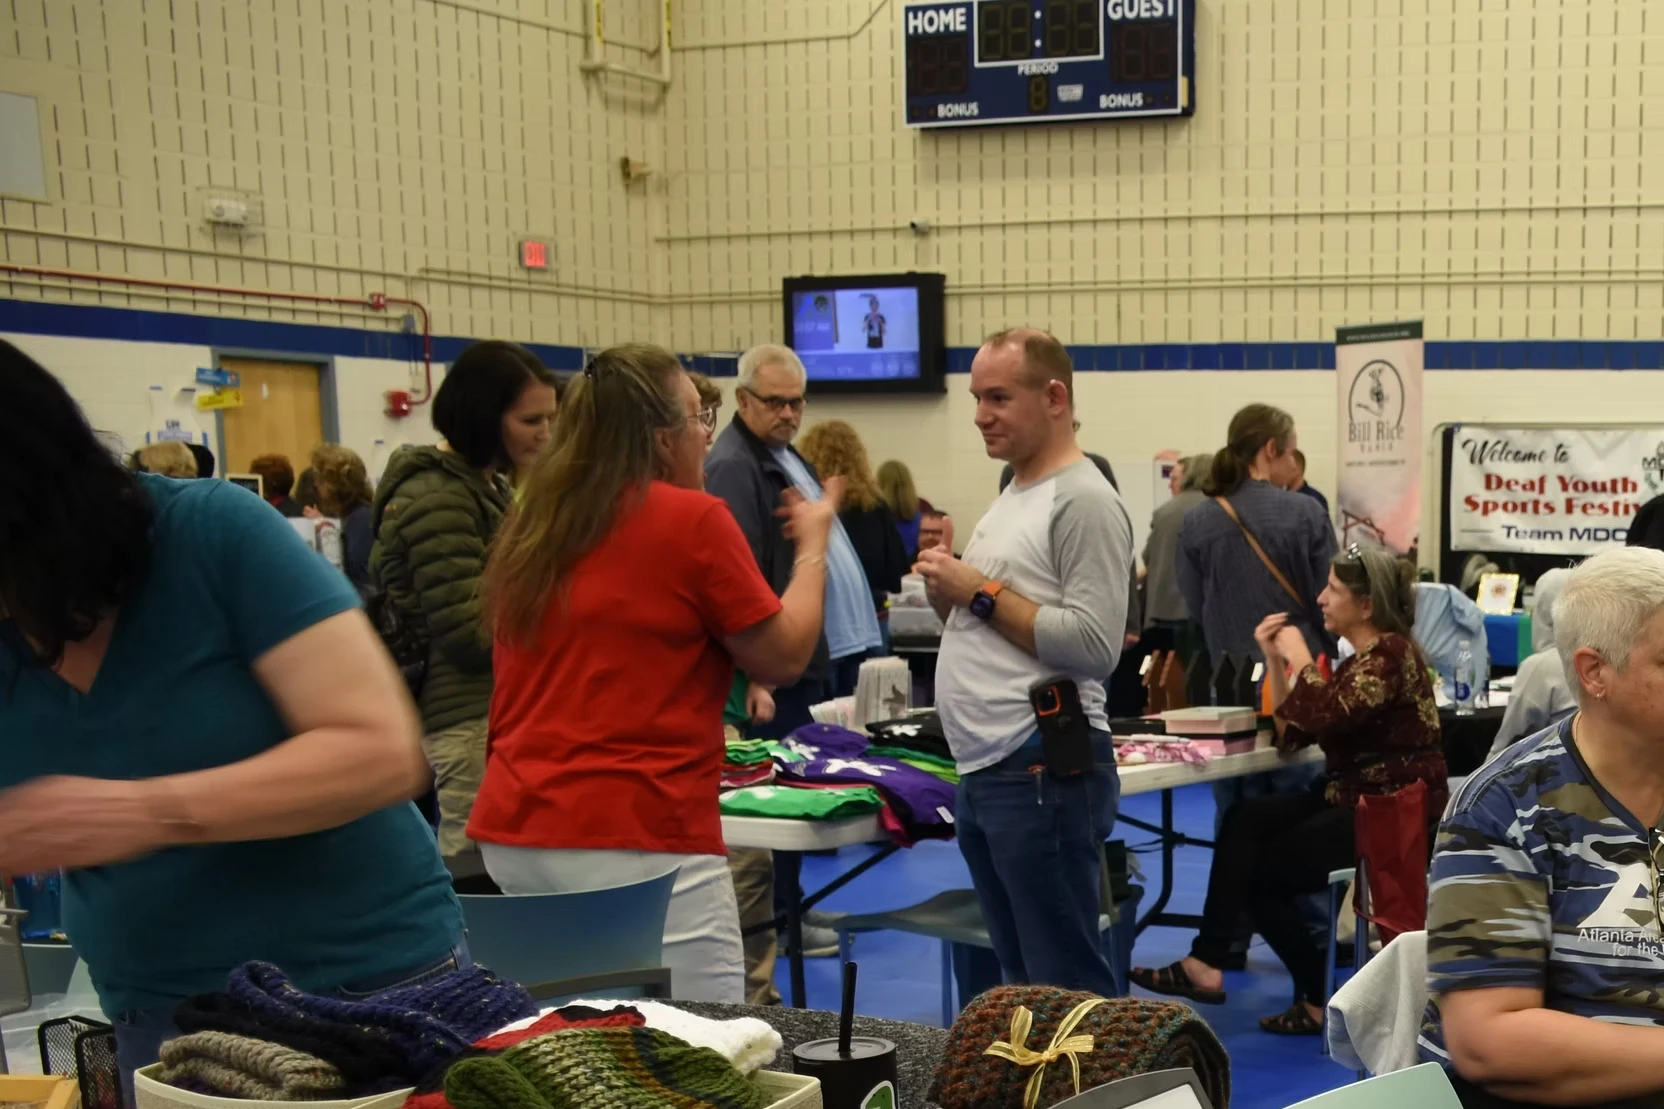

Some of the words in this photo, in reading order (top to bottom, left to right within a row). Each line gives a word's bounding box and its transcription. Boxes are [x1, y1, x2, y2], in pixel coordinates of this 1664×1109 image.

[1107, 0, 1174, 20] GUEST
[907, 8, 967, 34] HOME
[1018, 62, 1059, 75] PERIOD
[1100, 93, 1143, 108] BONUS
[937, 103, 979, 117] BONUS
[1348, 421, 1371, 442] Bill
[1376, 420, 1404, 441] Rice
[1461, 438, 1546, 465] Welcome
[1554, 443, 1571, 463] to
[1484, 473, 1546, 495] Deaf
[1557, 475, 1638, 494] Youth
[1464, 495, 1556, 517] Sports
[1565, 498, 1641, 516] Festiv
[1501, 525, 1563, 541] Team
[1577, 929, 1634, 943] Atlanta
[1612, 943, 1632, 957] for
[1637, 943, 1658, 956] the
